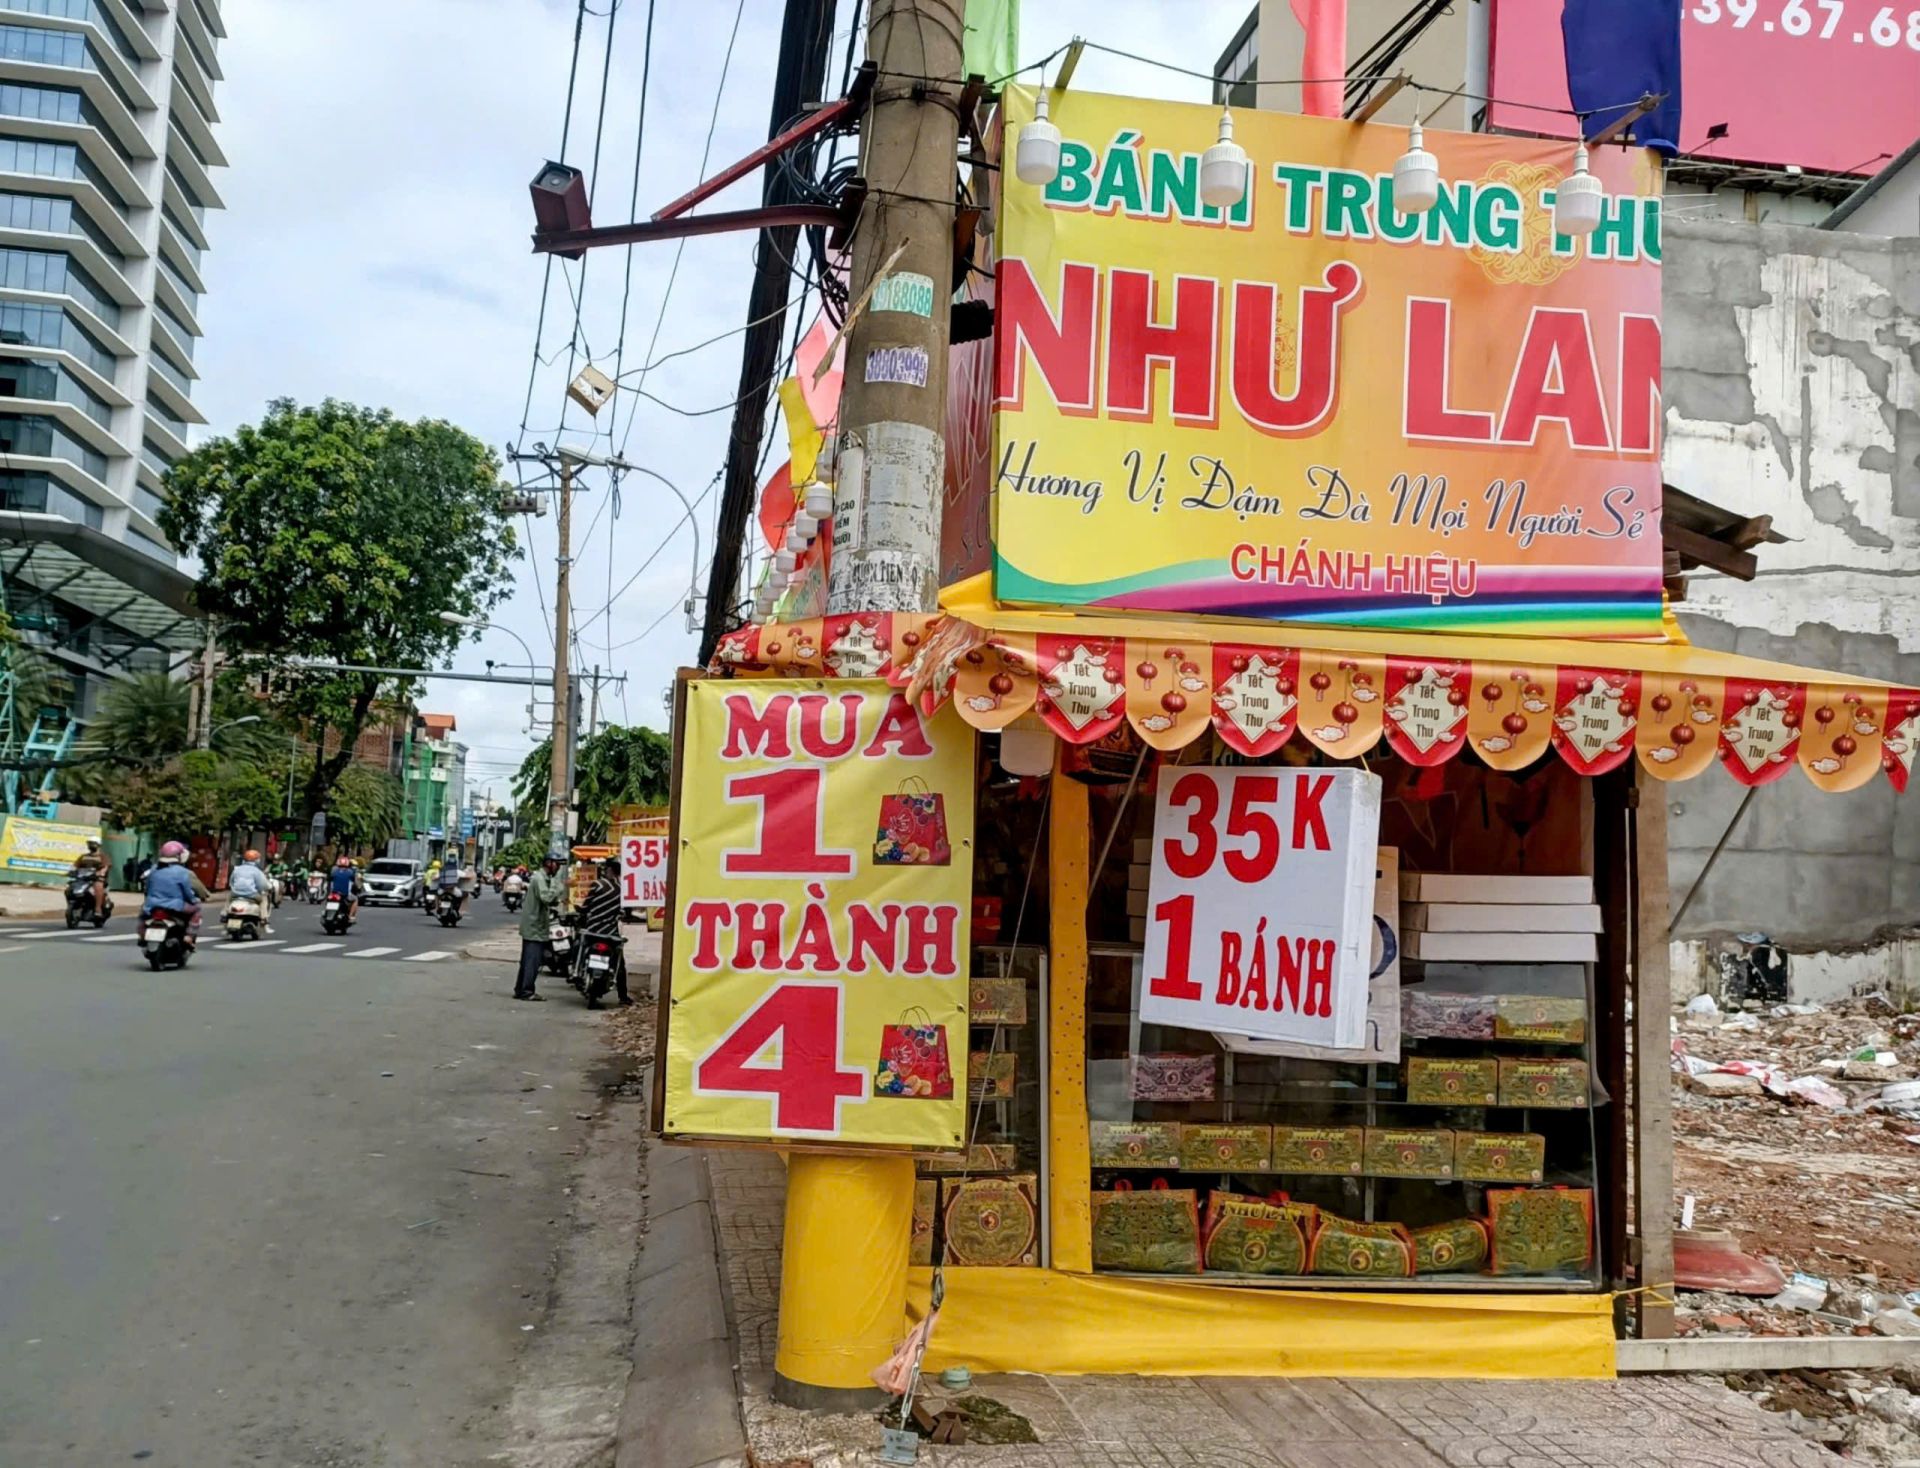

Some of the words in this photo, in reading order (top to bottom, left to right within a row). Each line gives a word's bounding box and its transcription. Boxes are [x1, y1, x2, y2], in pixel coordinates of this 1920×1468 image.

[1274, 162, 1522, 254] TRUNG
[996, 257, 1362, 431] NHƯ
[991, 440, 1102, 515] Hương
[1123, 449, 1168, 513] Vị
[1181, 455, 1281, 521] Đậm
[1299, 465, 1370, 521] Đà
[1389, 473, 1467, 538] Mọi
[1484, 479, 1583, 548] Người
[1586, 485, 1646, 539] Sẻ
[1230, 537, 1372, 592] CHÁNH
[1383, 551, 1478, 605] HIỆU
[1068, 682, 1097, 699] Trung
[1241, 693, 1269, 710] Trung
[1071, 701, 1091, 715] Thu
[1245, 713, 1263, 728] Thu
[1412, 704, 1440, 721] Trung
[721, 692, 934, 760] MUA
[1416, 723, 1434, 738] Thu
[1582, 715, 1609, 731] Trung
[1748, 727, 1774, 742] Trung
[1584, 734, 1602, 748] Thu
[1749, 745, 1765, 759] Thu
[723, 766, 853, 875] 1
[1163, 772, 1336, 884] 35K
[623, 872, 640, 901] 1
[685, 882, 960, 977] THÀNH
[1150, 894, 1203, 1001] 1
[1214, 915, 1337, 1019] BÁNH
[696, 982, 865, 1133] 4
